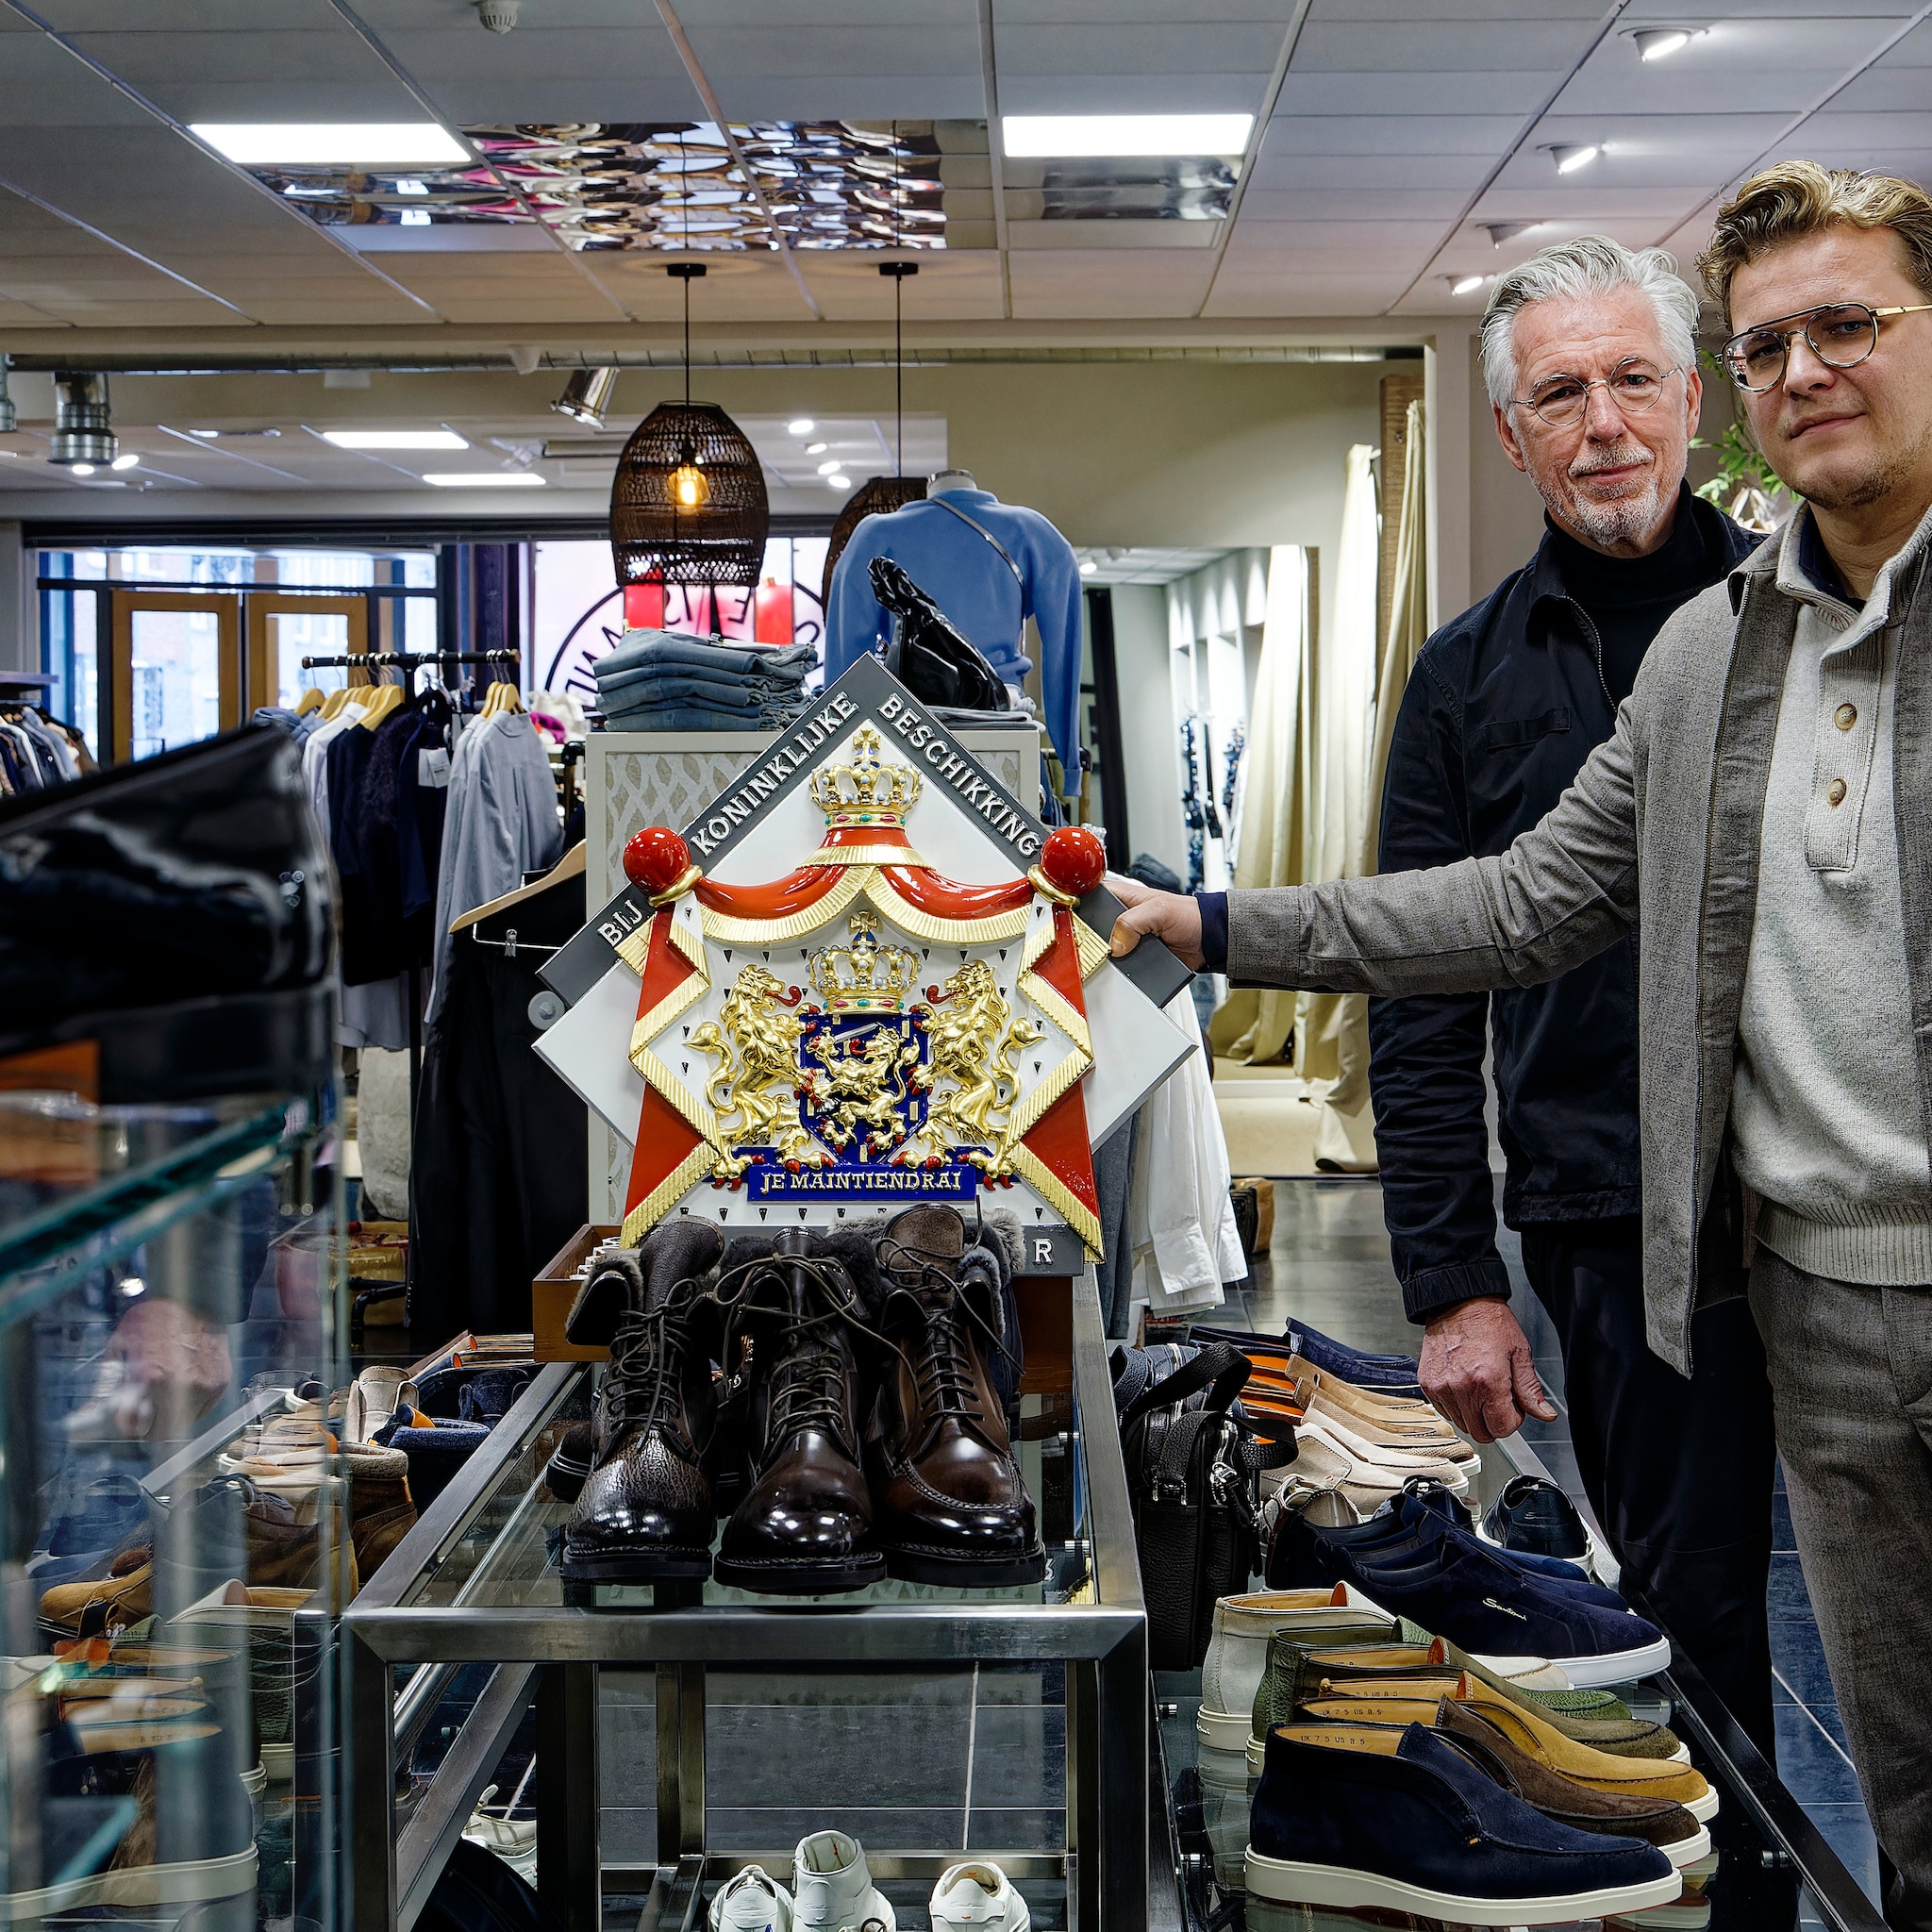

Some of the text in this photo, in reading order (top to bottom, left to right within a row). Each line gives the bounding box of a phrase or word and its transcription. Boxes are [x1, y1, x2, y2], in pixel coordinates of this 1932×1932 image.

[597, 691, 859, 947] BIJ KONINKLIJKE
[876, 692, 1042, 858] BESCHIKKING
[760, 1170, 962, 1194] JE MAINTIENDRAI
